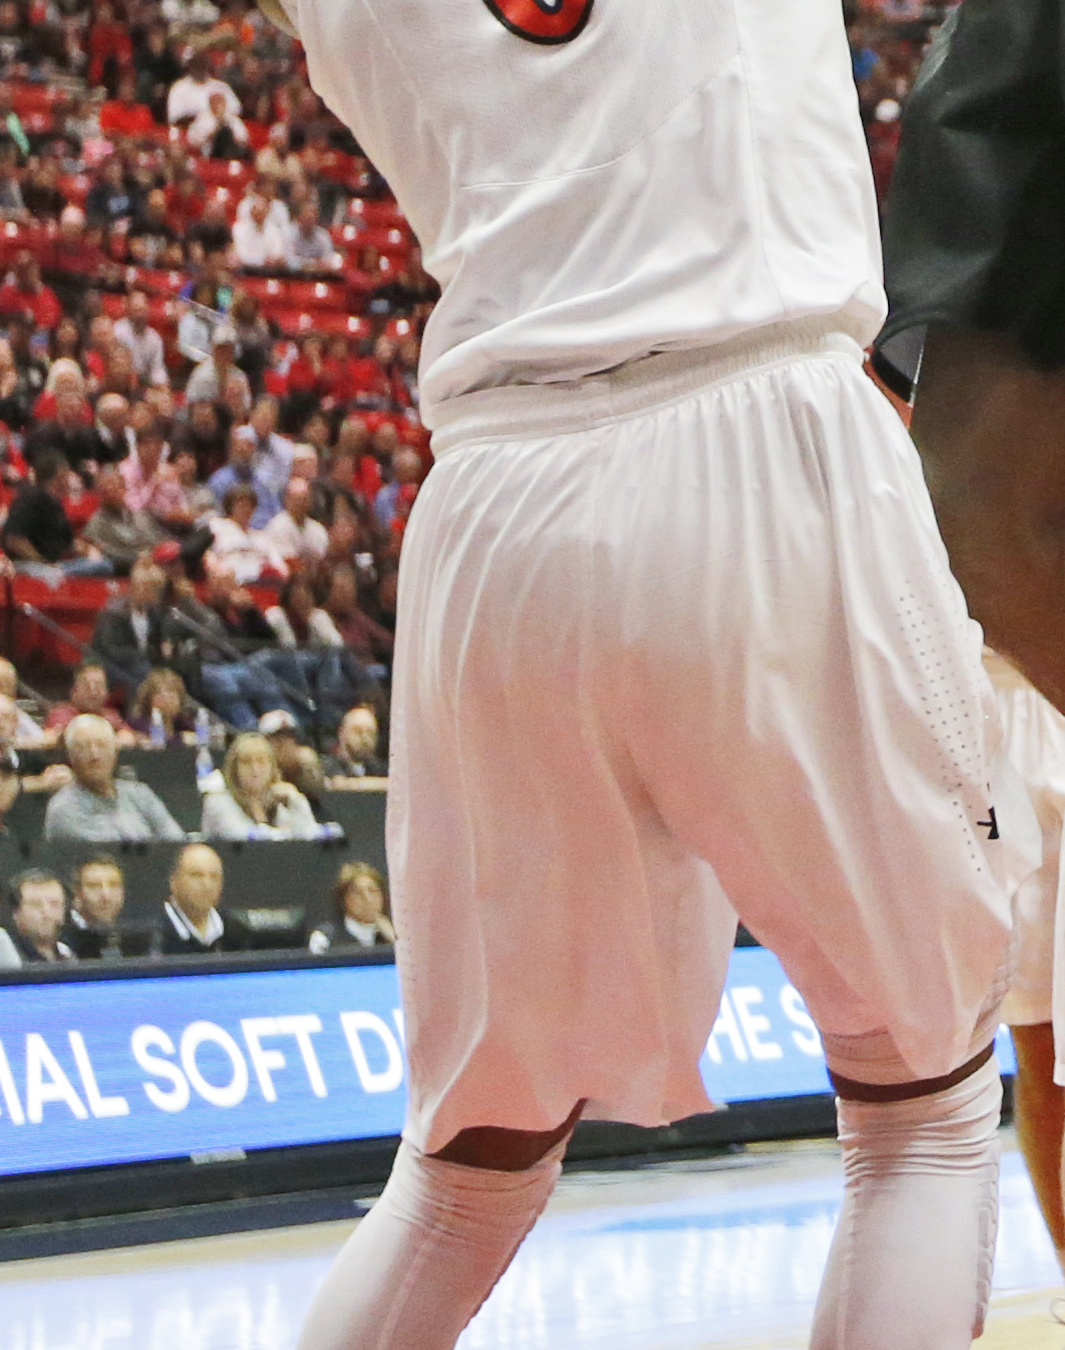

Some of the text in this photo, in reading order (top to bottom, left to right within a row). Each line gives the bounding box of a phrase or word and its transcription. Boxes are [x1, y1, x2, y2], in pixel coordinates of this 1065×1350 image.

[0, 1008, 406, 1125] IAL SOFT D
